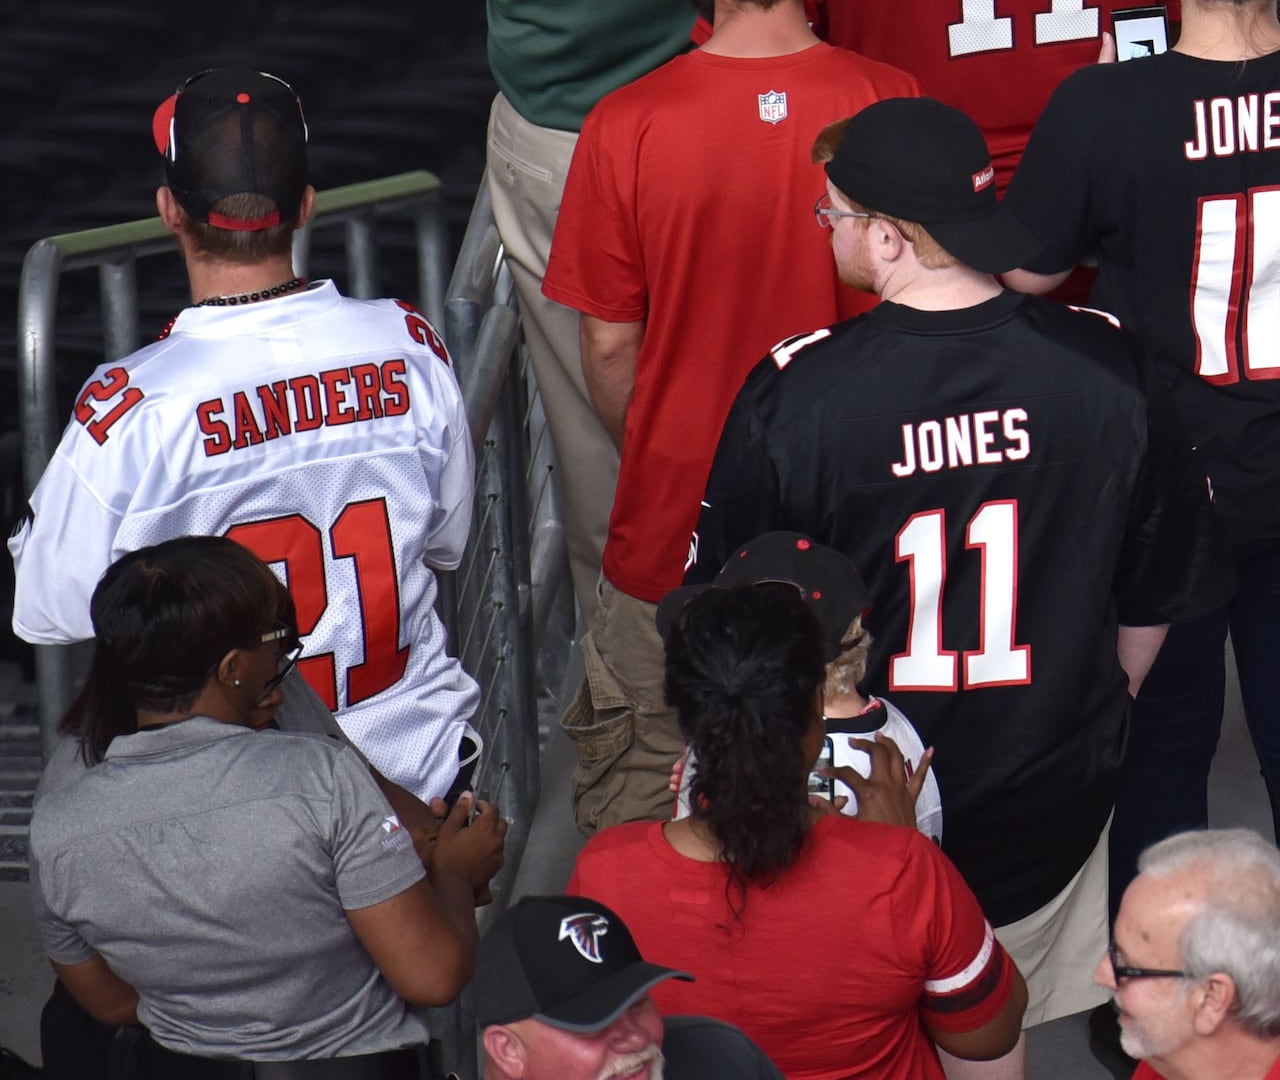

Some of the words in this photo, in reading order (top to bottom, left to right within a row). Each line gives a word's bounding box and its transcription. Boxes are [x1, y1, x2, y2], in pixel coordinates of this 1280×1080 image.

[74, 366, 144, 447] 21
[196, 358, 410, 457] SANDERS
[891, 408, 1031, 477] JONES
[888, 498, 1032, 693] 11
